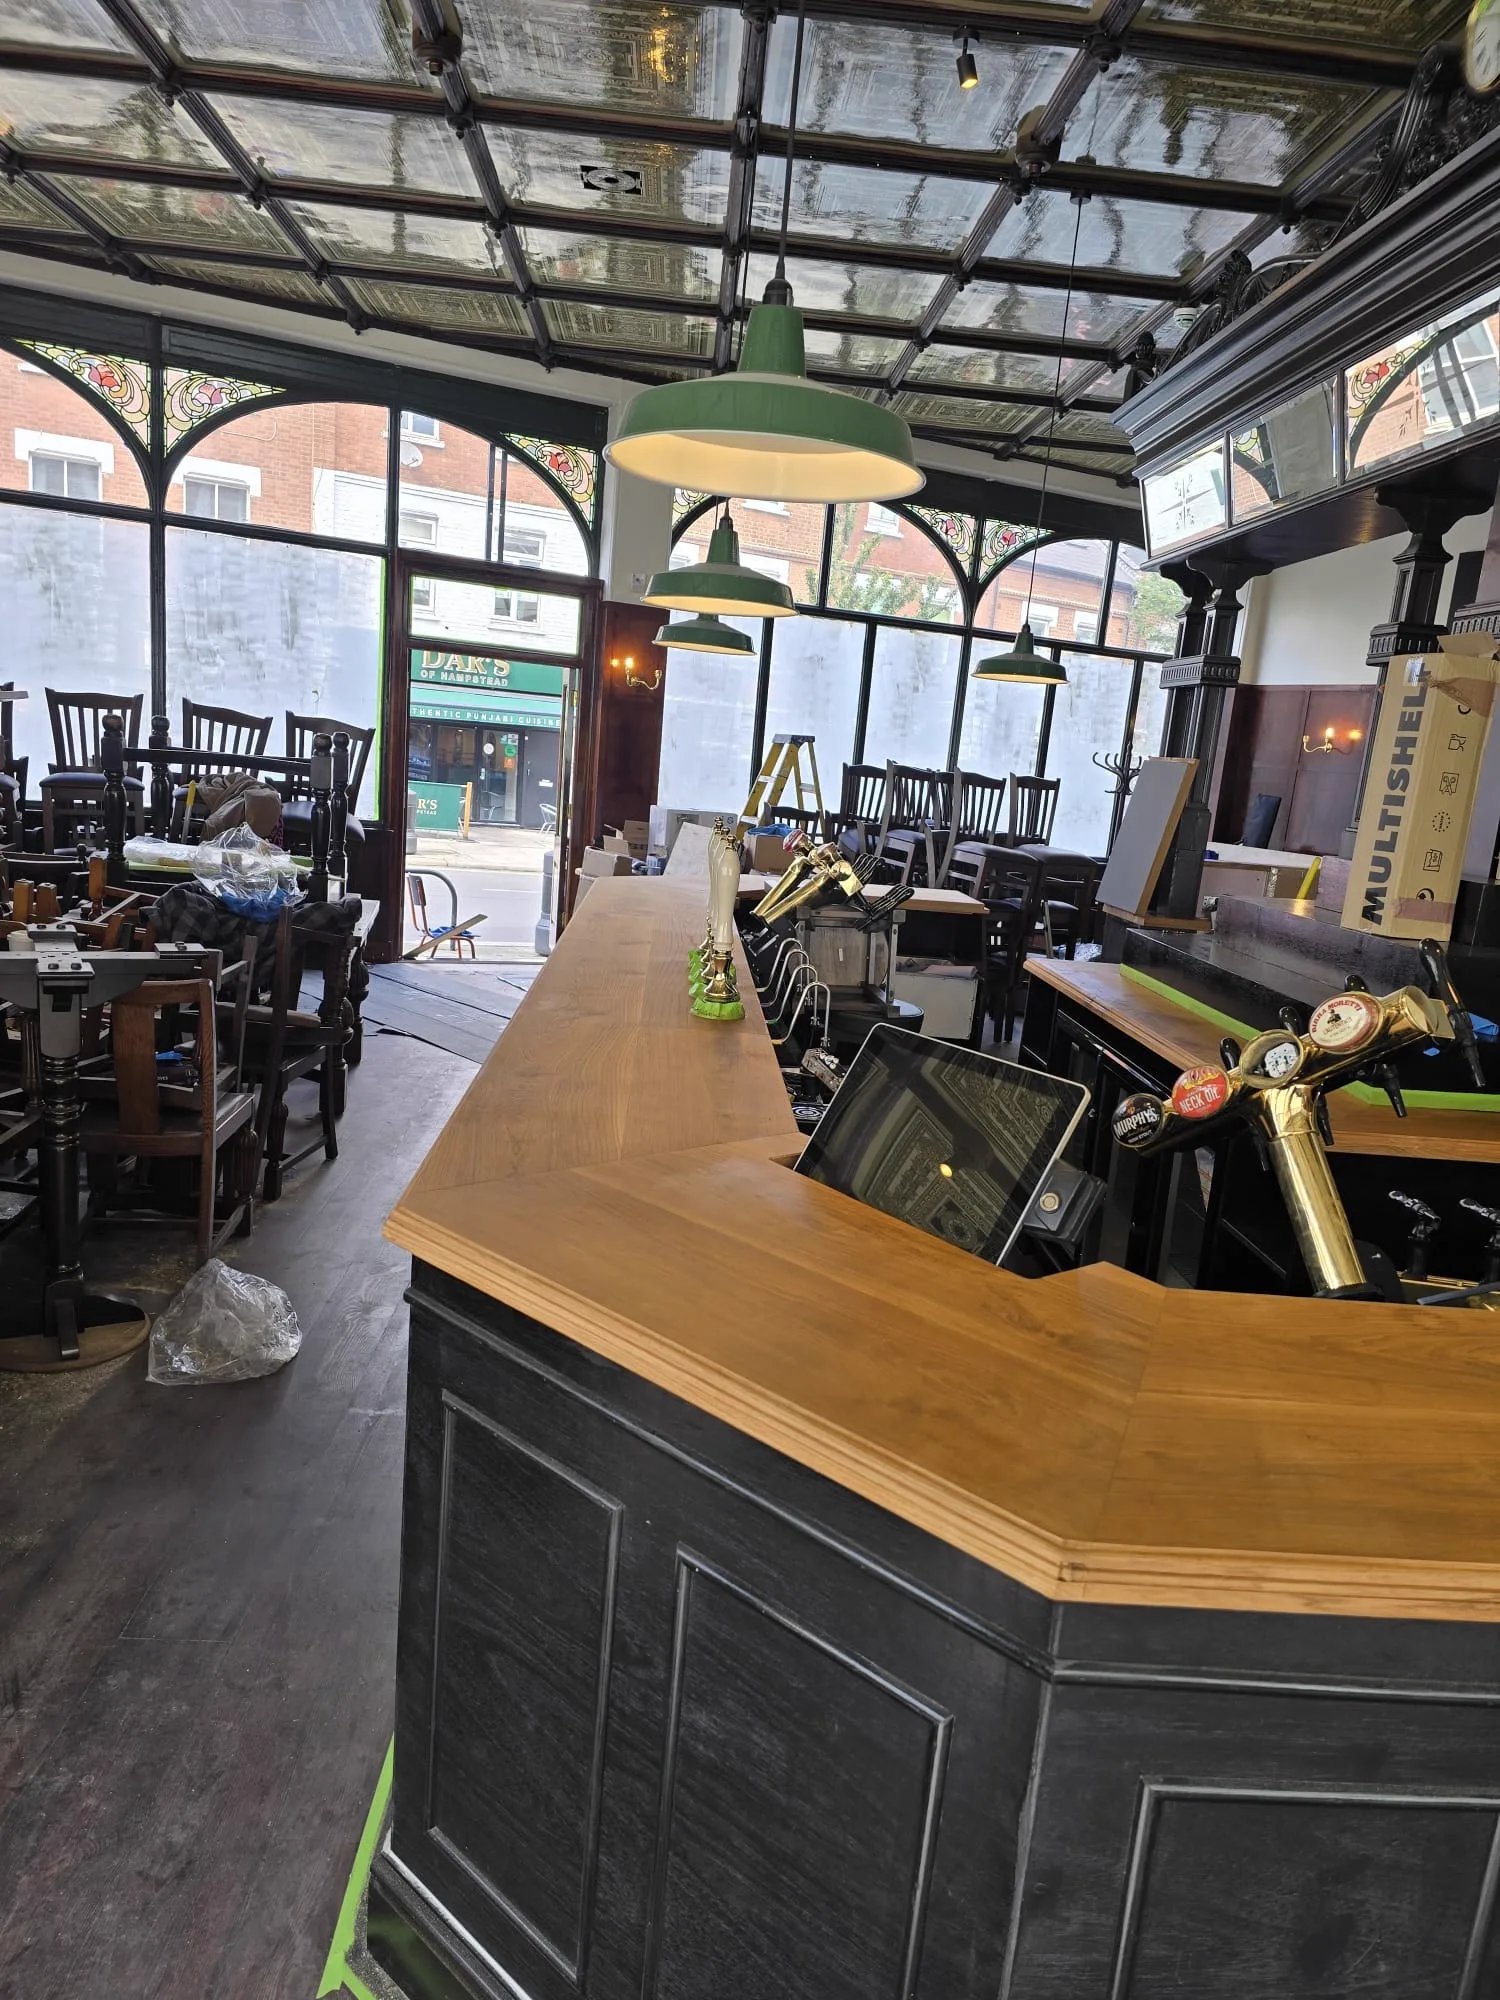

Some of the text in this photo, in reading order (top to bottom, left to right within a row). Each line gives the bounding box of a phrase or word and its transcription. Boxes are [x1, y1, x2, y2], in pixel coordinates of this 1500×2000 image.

[421, 650, 511, 677] DAR'S
[420, 669, 508, 687] OF HAMPSTEAD
[411, 707, 561, 727] THENTIC PUNJABI CUISINE
[417, 798, 438, 810] R'S
[1311, 1008, 1327, 1033] BIRRA
[1328, 999, 1362, 1012] MORETTI
[1179, 1094, 1205, 1113] NECK
[1203, 1087, 1221, 1102] OIL
[1113, 1107, 1159, 1139] MURPHY'S
